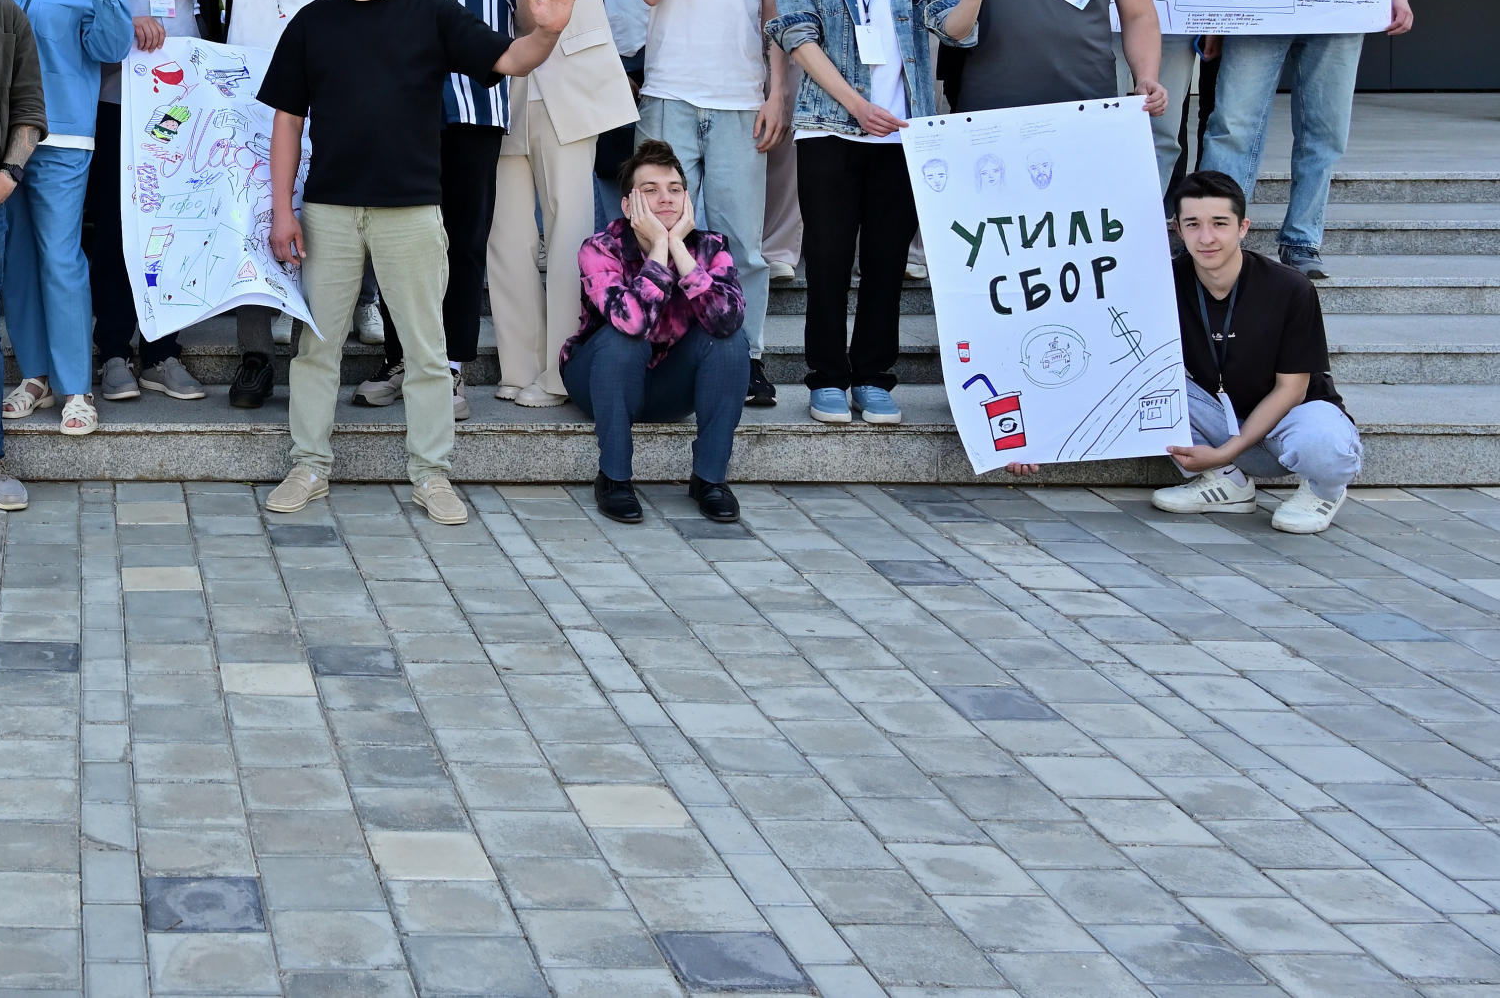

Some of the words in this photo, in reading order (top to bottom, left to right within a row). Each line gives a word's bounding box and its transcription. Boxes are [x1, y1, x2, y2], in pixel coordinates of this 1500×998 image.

[950, 208, 1124, 271] УТИЛЬ
[989, 256, 1117, 315] СБОР
[1141, 397, 1168, 408] COFFEE
